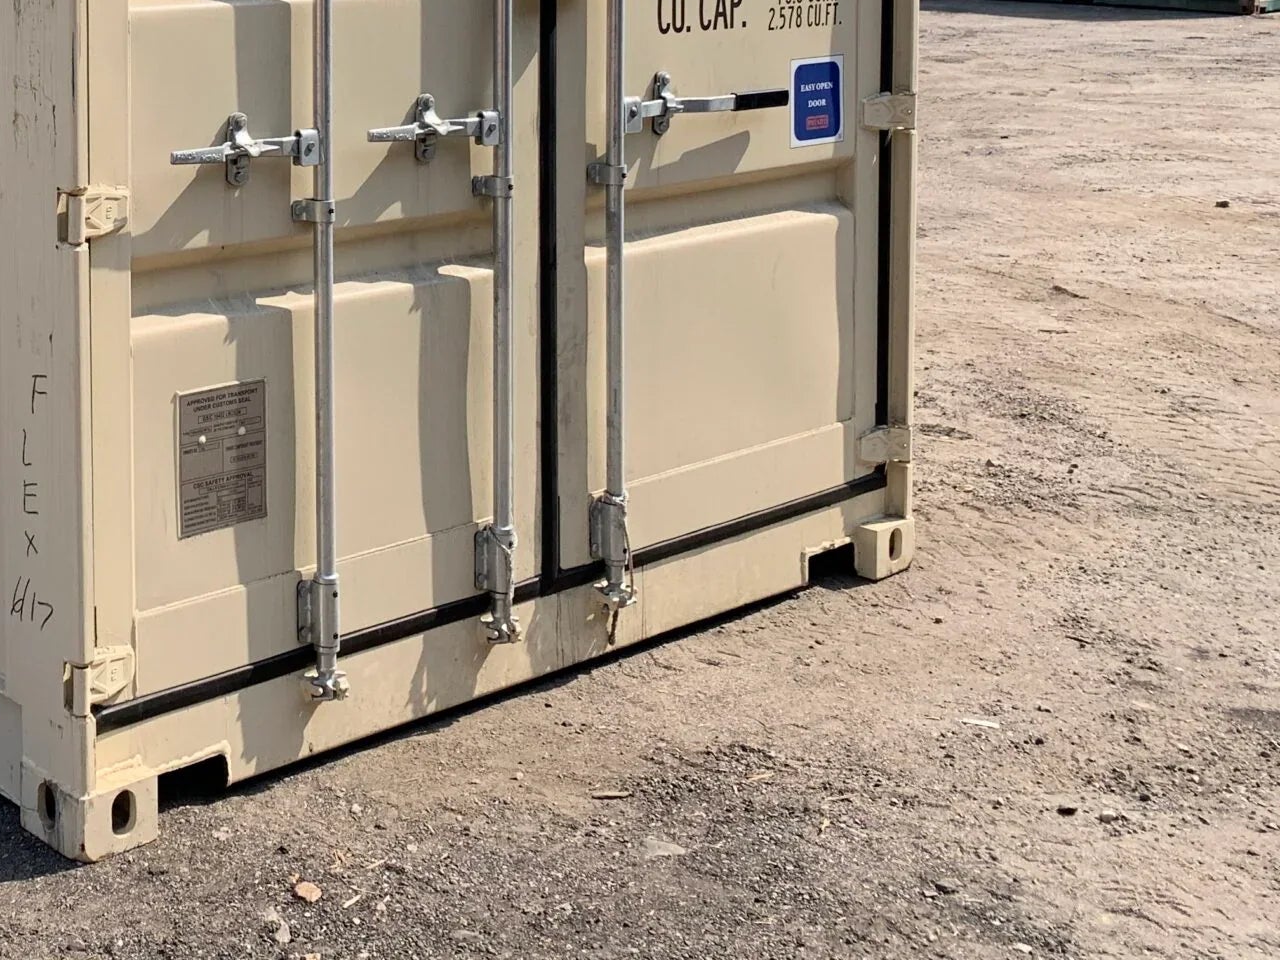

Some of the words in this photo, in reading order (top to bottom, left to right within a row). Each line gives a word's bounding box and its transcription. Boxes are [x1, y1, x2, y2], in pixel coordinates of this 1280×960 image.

[800, 83, 816, 92] EASY
[816, 81, 833, 90] OPEN
[808, 99, 827, 108] DOOR
[187, 396, 215, 407] APPROVED
[216, 393, 227, 401] FOR
[228, 388, 258, 398] TRANSPORT
[193, 403, 212, 412] UNDER
[212, 398, 237, 408] CUSTOMS
[23, 375, 47, 558] FLEX
[205, 477, 225, 486] SAFETY
[226, 472, 254, 481] APPROVAL
